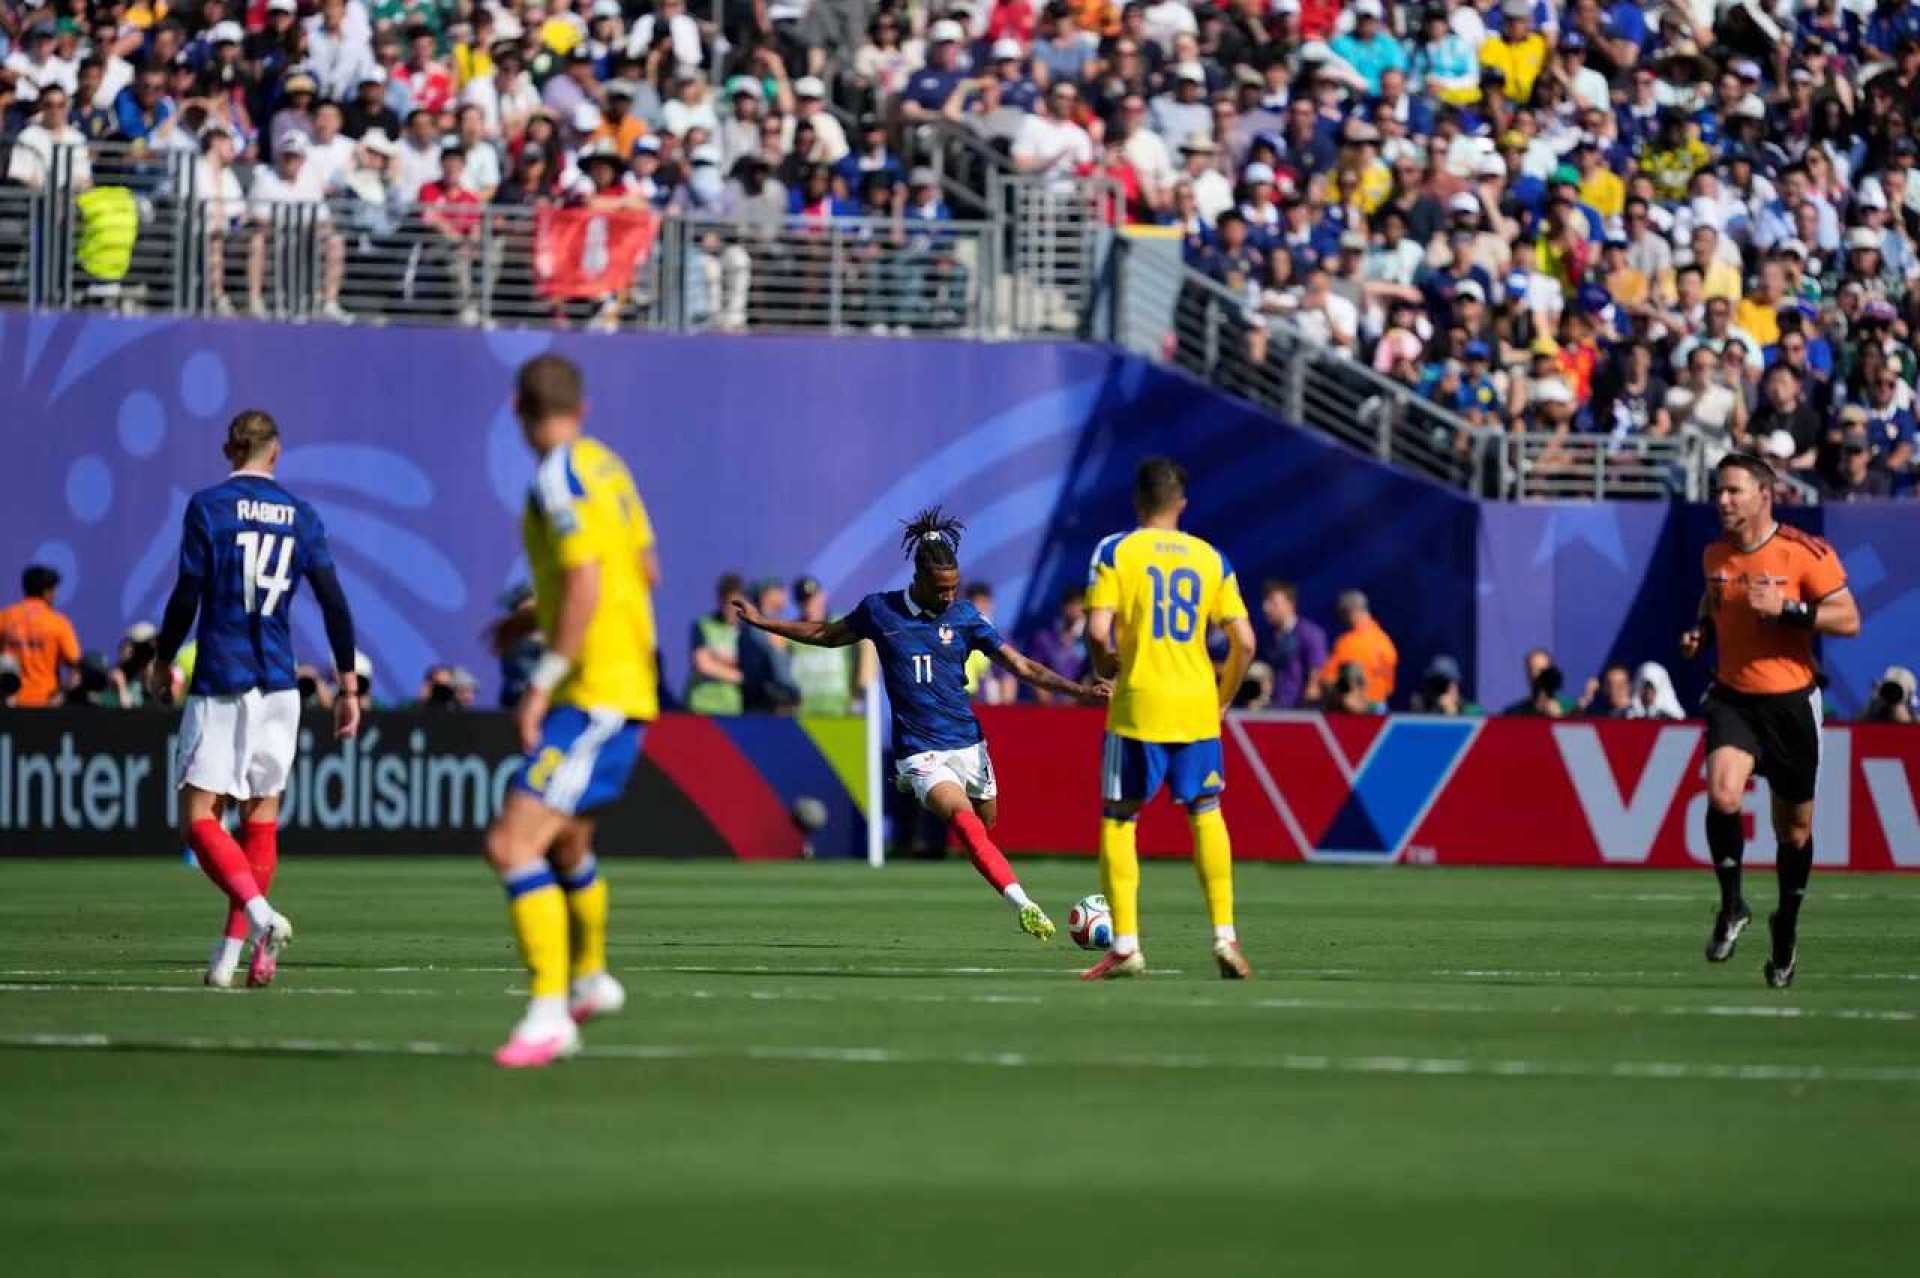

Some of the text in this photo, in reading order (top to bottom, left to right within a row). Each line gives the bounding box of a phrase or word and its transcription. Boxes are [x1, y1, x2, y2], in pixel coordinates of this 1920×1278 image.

[236, 499, 297, 525] RABIOT
[235, 530, 295, 616] 14
[1146, 563, 1202, 643] 18
[911, 654, 932, 684] 11
[0, 731, 150, 830] Inter
